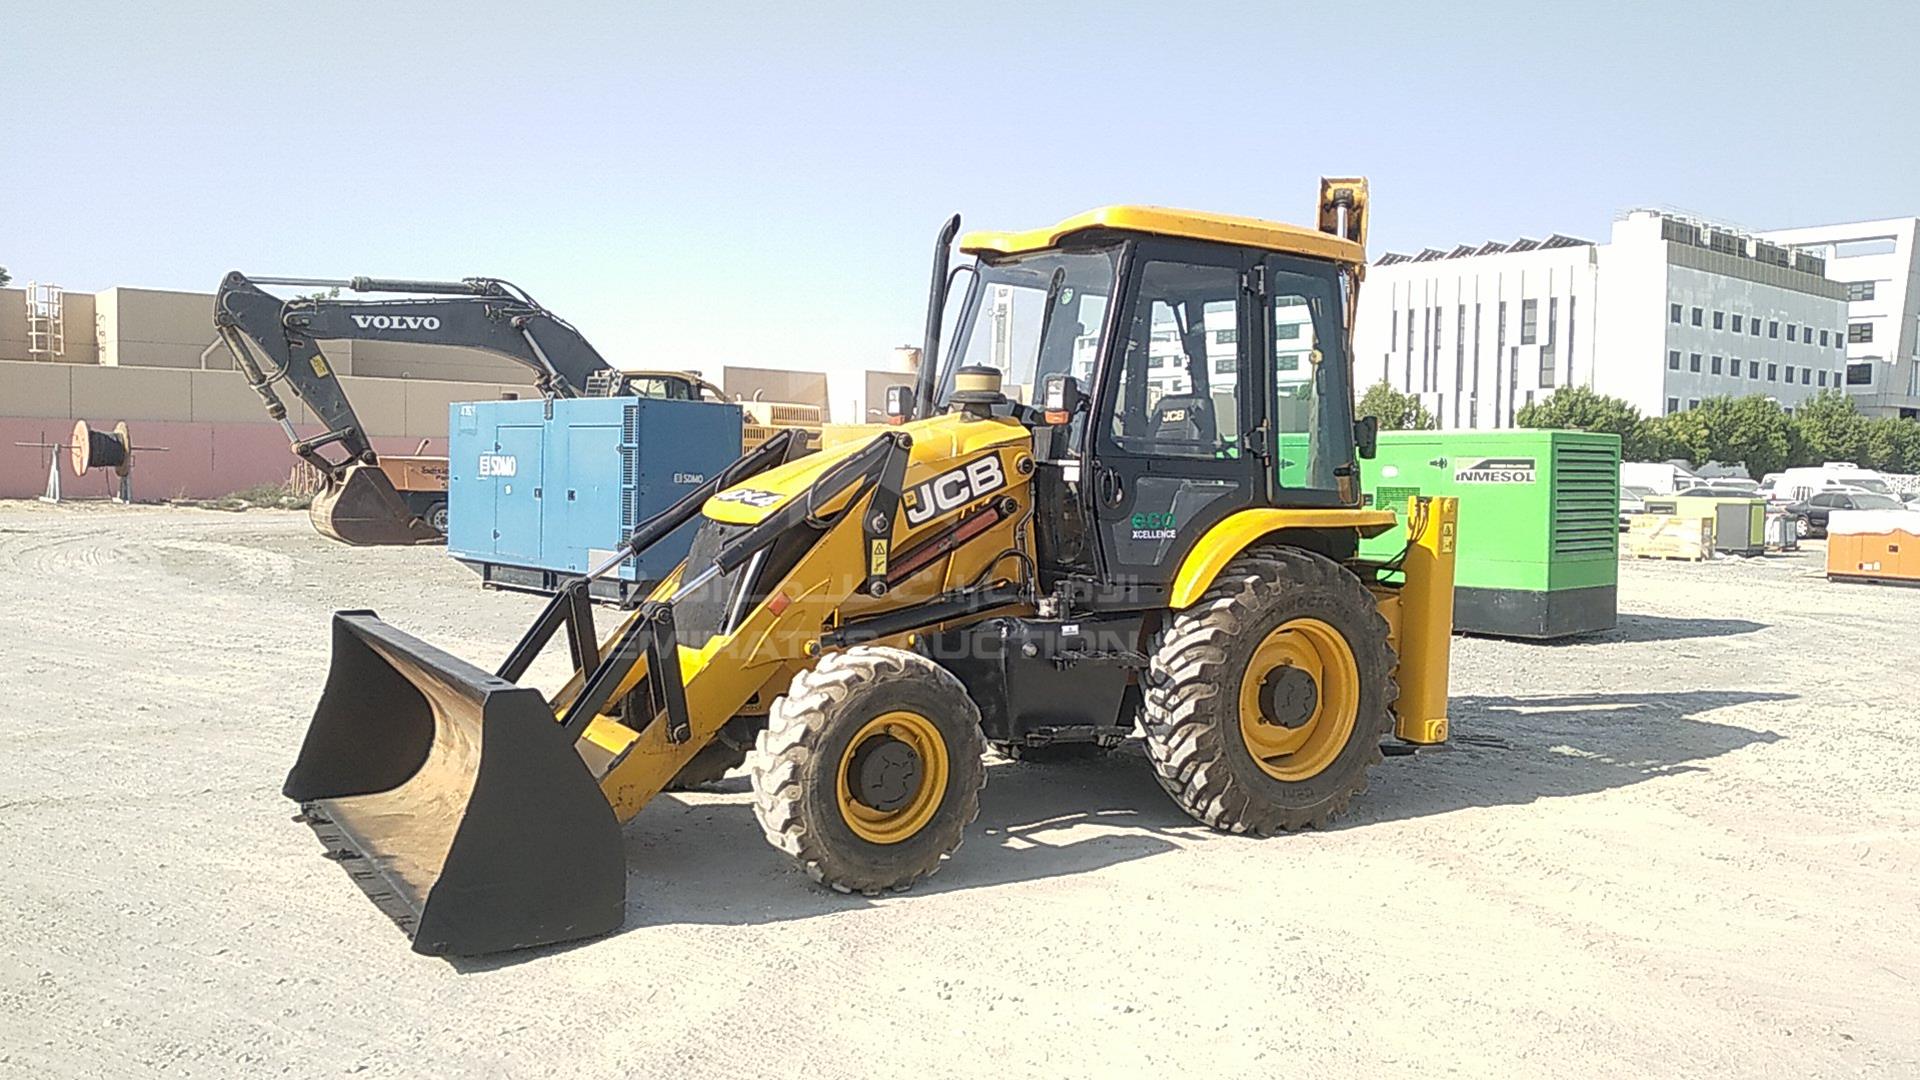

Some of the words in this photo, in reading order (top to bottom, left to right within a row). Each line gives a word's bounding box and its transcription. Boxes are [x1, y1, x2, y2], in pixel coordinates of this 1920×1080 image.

[350, 314, 440, 330] VOLVO
[1162, 409, 1185, 422] JCB
[1455, 471, 1535, 482] INMESOL
[906, 455, 1004, 524] JCB
[1132, 529, 1177, 539] XCELLENCE
